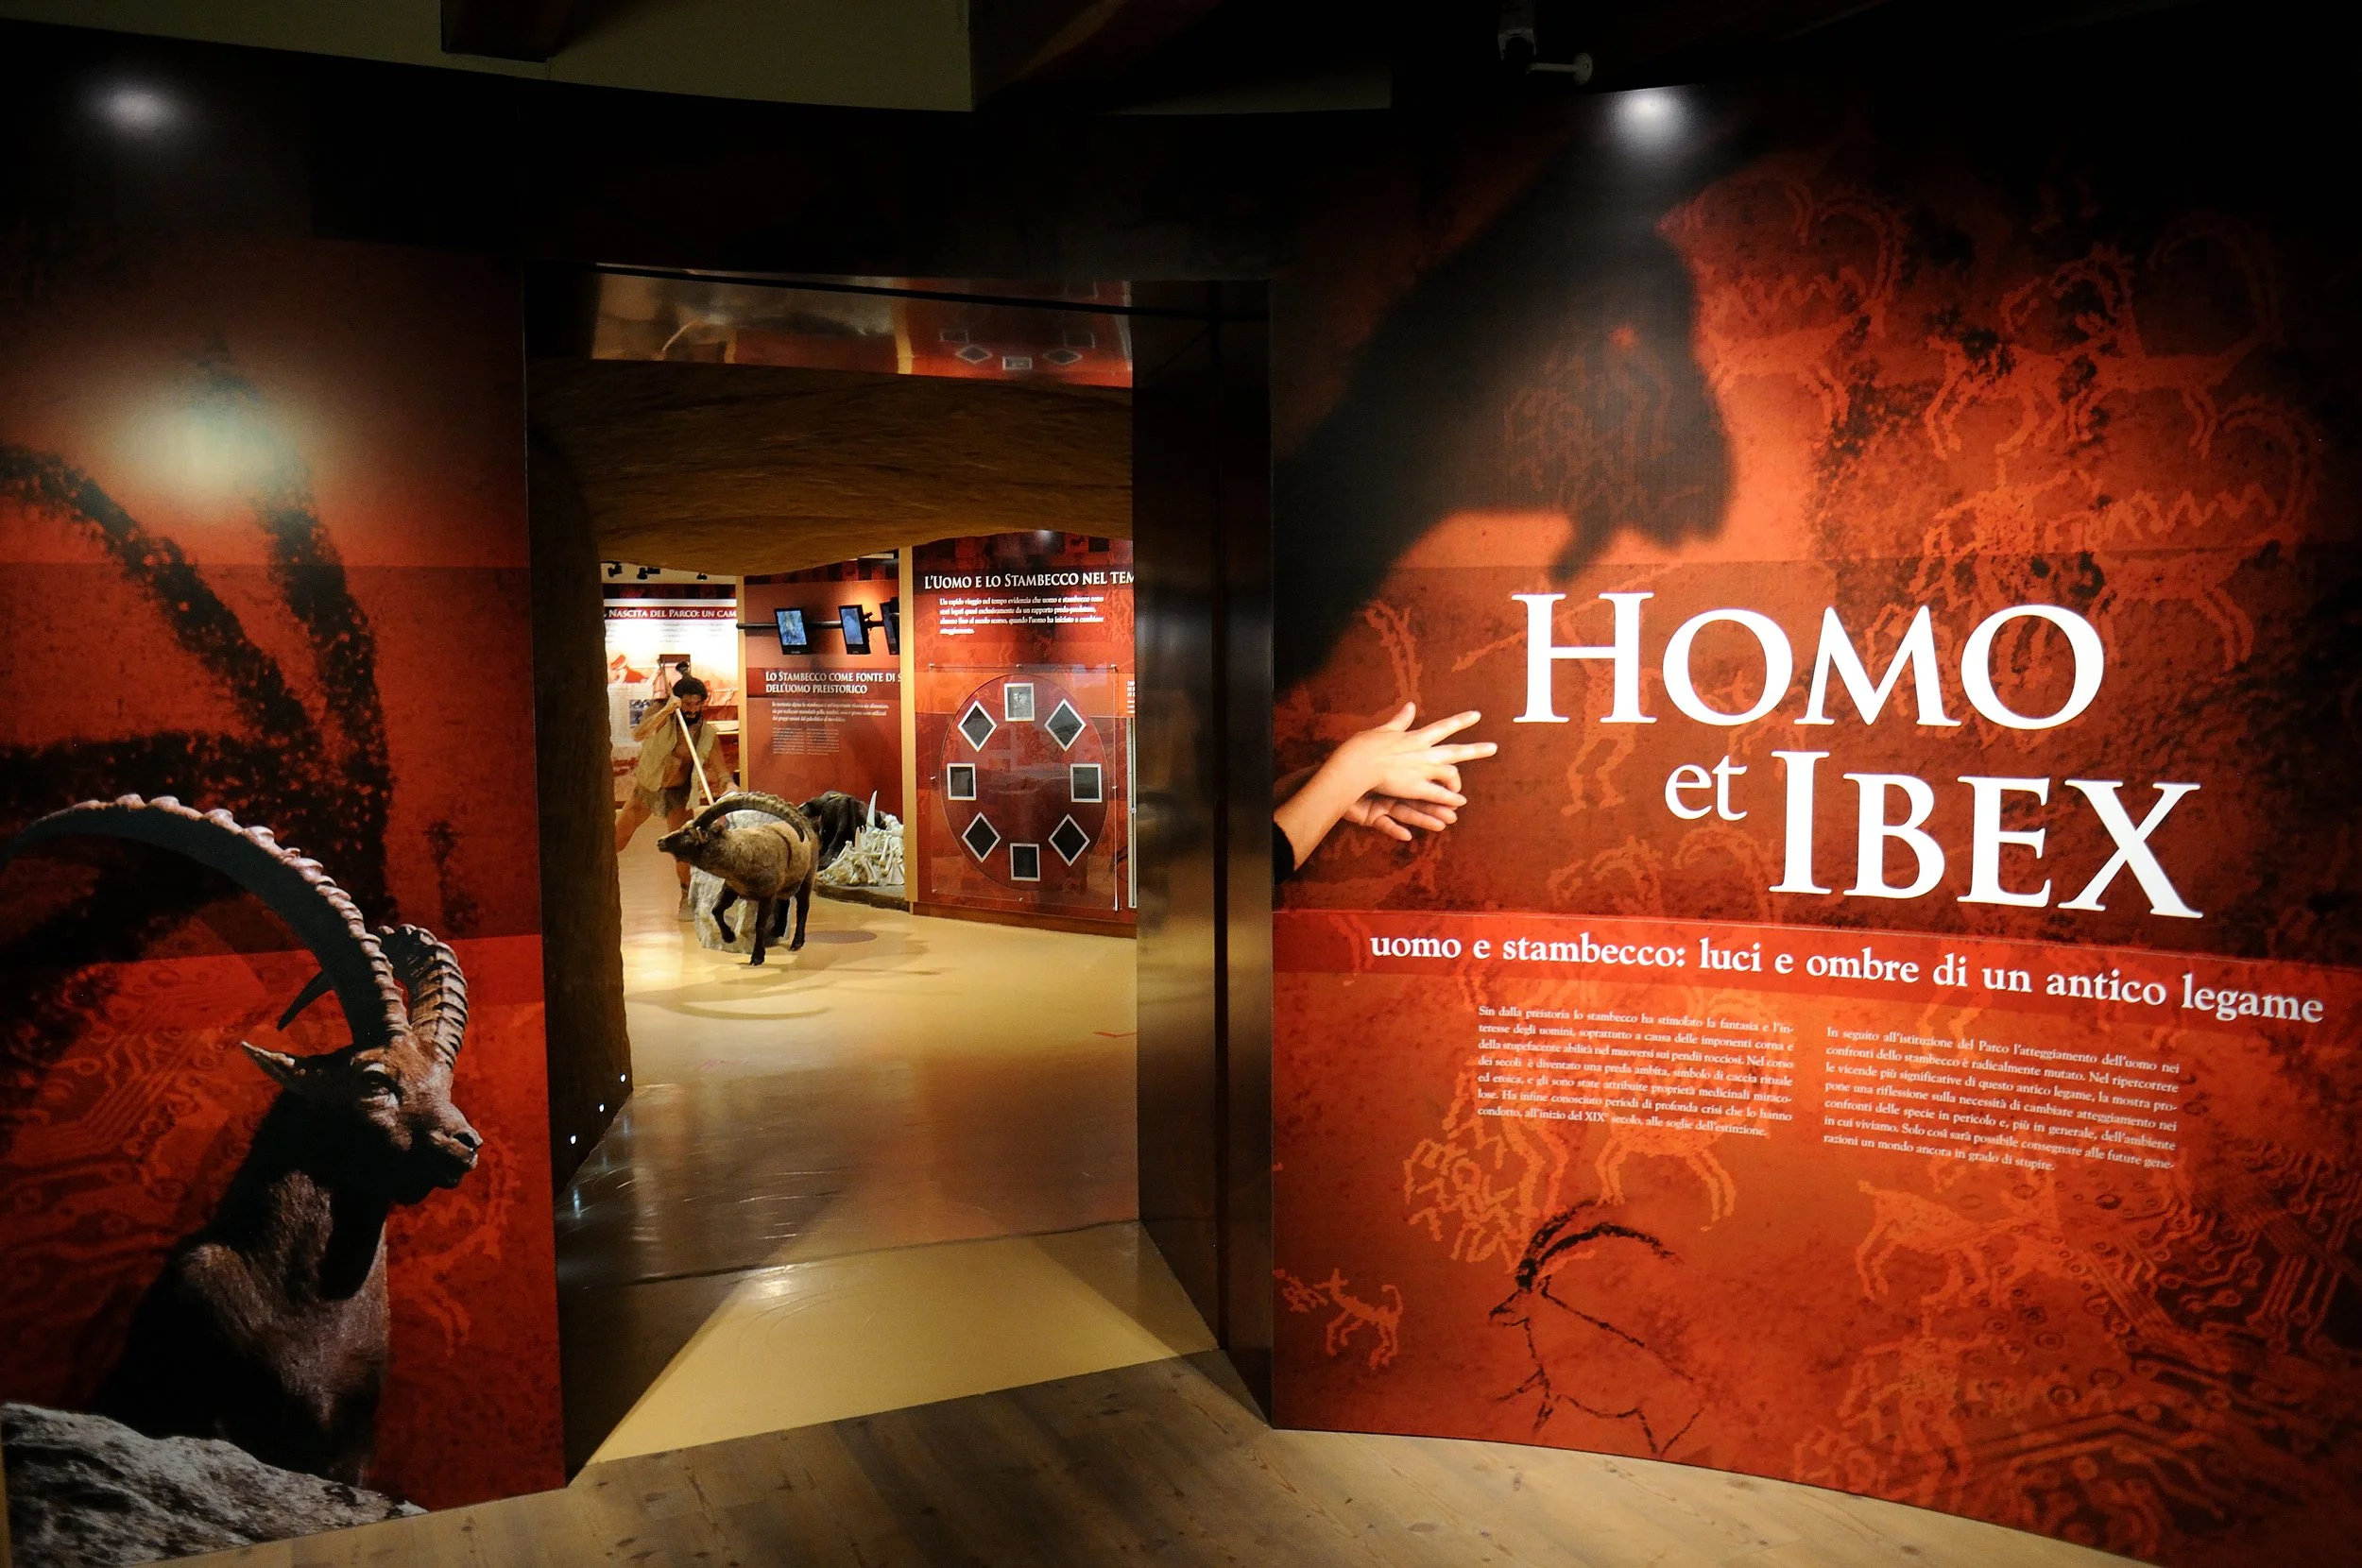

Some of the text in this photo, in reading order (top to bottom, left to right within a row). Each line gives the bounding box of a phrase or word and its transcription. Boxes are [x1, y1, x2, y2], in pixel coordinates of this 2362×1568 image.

[975, 576, 983, 588] E
[985, 575, 1001, 588] LO
[1004, 572, 1079, 587] STAMBECCO
[1082, 571, 1107, 586] NEL
[608, 609, 647, 618] NASCITA
[650, 609, 667, 618] DEL
[702, 609, 714, 618] UN
[1512, 592, 2104, 730] HOMO
[765, 672, 778, 682] LO
[779, 672, 827, 682] STAMBECCO
[829, 672, 854, 682] COME
[856, 673, 883, 682] FONTE
[886, 673, 896, 682] DI
[813, 684, 867, 694] PREISTORICO
[1665, 751, 2202, 919] et IBEX
[1370, 931, 2324, 1023] uomo e stambecco: luci e ombre di un antico legame
[1478, 1005, 1758, 1031] Sin dalla preistoria lo stambecco ha stimolato la fantasia
[1478, 1025, 1510, 1033] teresse
[1513, 1024, 1536, 1036] degli
[1579, 1030, 1632, 1040] soprattutto
[1674, 1032, 1698, 1044] delle
[1701, 1035, 1752, 1048] imponenti
[1754, 1041, 1784, 1050] corna
[1826, 1026, 1839, 1037] In
[1842, 1031, 1879, 1041] seguito
[1957, 1038, 1974, 1050] del
[1978, 1040, 2009, 1053] Parco
[2161, 1064, 2180, 1074] nei
[1478, 1039, 1501, 1049] della
[1594, 1044, 1610, 1055] nel
[1611, 1048, 1653, 1058] muoversi
[1655, 1050, 1669, 1059] sui
[1670, 1050, 1703, 1062] pendii
[1746, 1055, 1765, 1066] Nel
[1766, 1060, 1793, 1068] corso
[1478, 1055, 1493, 1065] dei
[1495, 1057, 1521, 1066] secoli
[1536, 1058, 1581, 1070] diventato
[1583, 1064, 1602, 1072] una
[1604, 1063, 1632, 1074] preda
[1672, 1067, 1711, 1079] simbolo
[1713, 1069, 1723, 1081] di
[1725, 1074, 1757, 1083] caccia
[1759, 1075, 1792, 1086] rituale
[1825, 1046, 1874, 1058] confronti
[1875, 1048, 1902, 1061] dello
[1904, 1054, 1960, 1066] stambecco
[1971, 1060, 2041, 1076] radicalmente
[2088, 1071, 2109, 1083] Nel
[2112, 1076, 2179, 1093] ripercorrere
[1825, 1061, 1836, 1073] le
[1838, 1065, 1877, 1077] vicende
[1880, 1068, 1896, 1080] più
[1899, 1070, 1961, 1085] significative
[1964, 1076, 1976, 1087] di
[1977, 1081, 2014, 1091] questo
[2016, 1084, 2050, 1096] antico
[2097, 1090, 2109, 1103] la
[2112, 1097, 2150, 1108] mostra
[1501, 1089, 1517, 1100] Ha
[1604, 1098, 1638, 1108] periodi
[1641, 1099, 1652, 1109] di
[1654, 1100, 1698, 1113] profonda
[1701, 1105, 1721, 1115] crisi
[1724, 1105, 1742, 1116] che
[1746, 1106, 1756, 1117] lo
[1759, 1108, 1792, 1121] hanno
[1577, 1080, 1600, 1088] state
[1698, 1087, 1750, 1099] medicinali
[1567, 1110, 1583, 1121] del
[1645, 1116, 1663, 1127] alle
[1823, 1099, 1872, 1112] confronti
[1874, 1102, 1900, 1115] delle
[1903, 1108, 1935, 1119] specie
[1938, 1110, 1950, 1120] in
[1952, 1114, 1995, 1126] pericolo
[2012, 1120, 2029, 1132] più
[2033, 1122, 2045, 1133] in
[1824, 1082, 2177, 1132] pone una riflessione sulla necessità di cambiare atteggiamento nei
[1823, 1116, 1835, 1126] in
[1837, 1118, 1854, 1128] cui
[1901, 1123, 1926, 1135] Solo
[2021, 1141, 2081, 1156] consegnare
[2084, 1147, 2105, 1160] alle
[2107, 1150, 2141, 1165] future
[1823, 1134, 1858, 1146] razioni
[1860, 1139, 1874, 1148] un
[1877, 1141, 1914, 1151] mondo
[1916, 1146, 1952, 1157] ancora
[1954, 1149, 1966, 1159] in
[1968, 1151, 1999, 1163] grado
[2001, 1153, 2012, 1165] di
